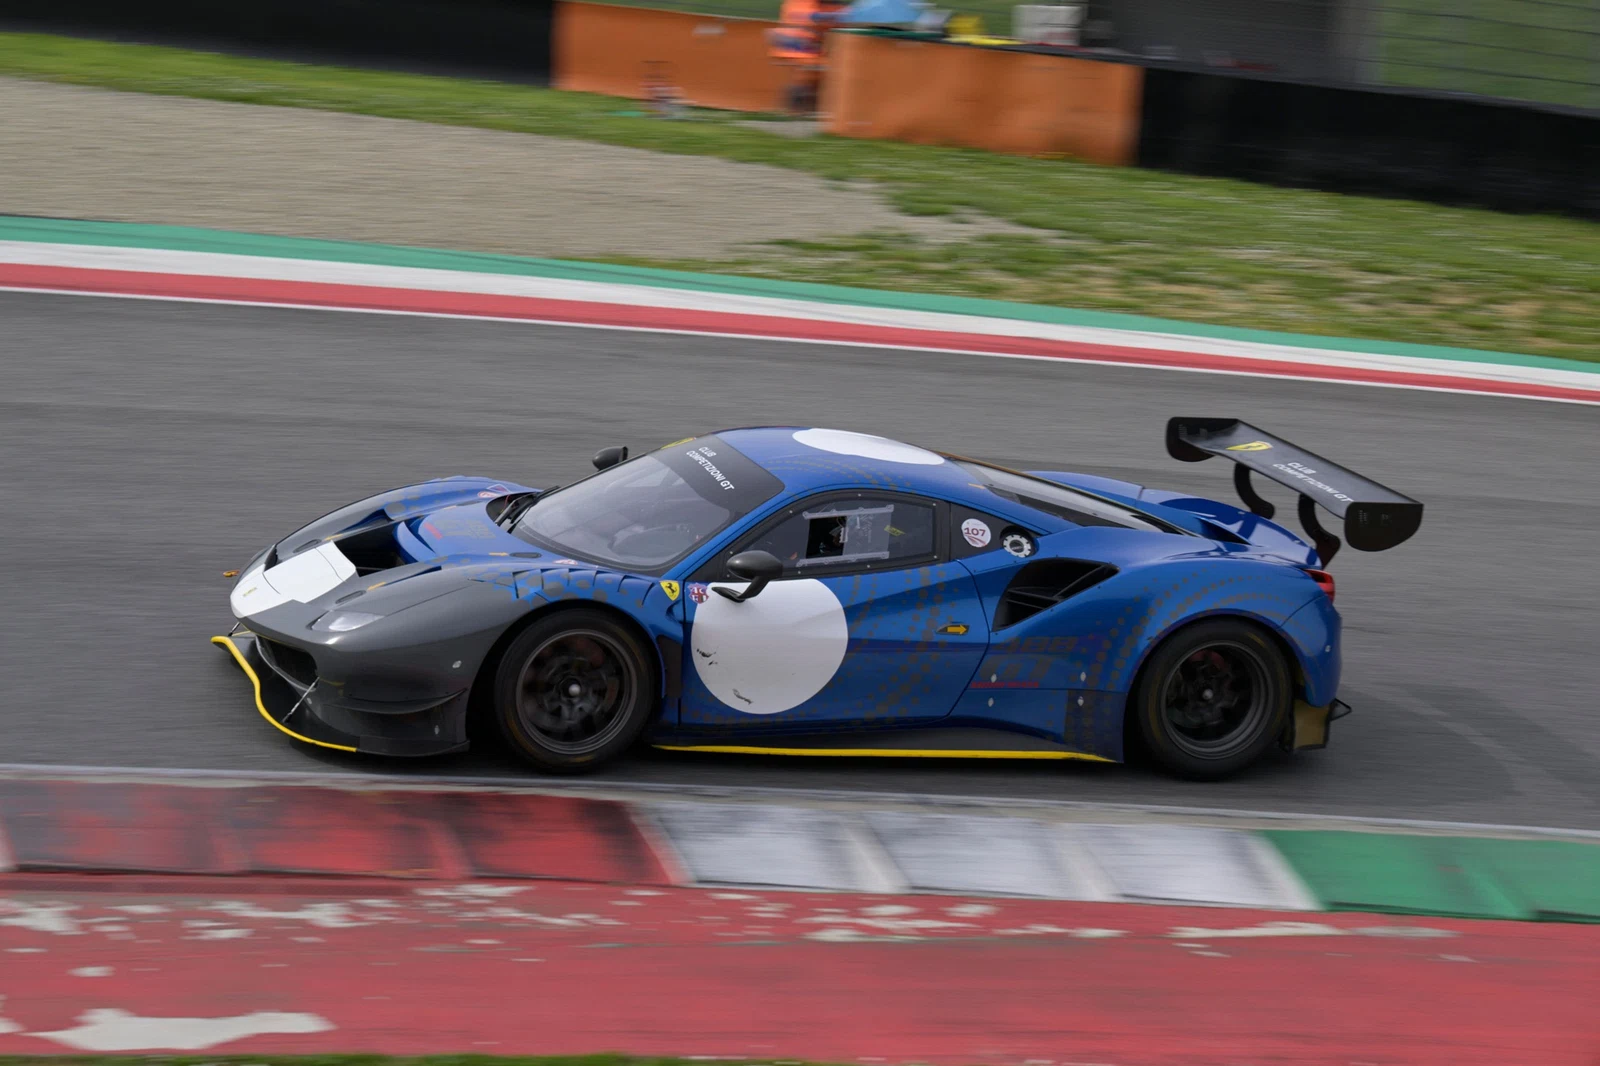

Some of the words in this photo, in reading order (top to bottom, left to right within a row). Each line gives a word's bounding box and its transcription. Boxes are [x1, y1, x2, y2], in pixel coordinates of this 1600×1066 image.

[698, 446, 717, 457] CLUB
[686, 450, 726, 481] COMPETIZIONI
[720, 480, 735, 490] GT
[1333, 493, 1354, 502] GT
[964, 527, 986, 537] 107
